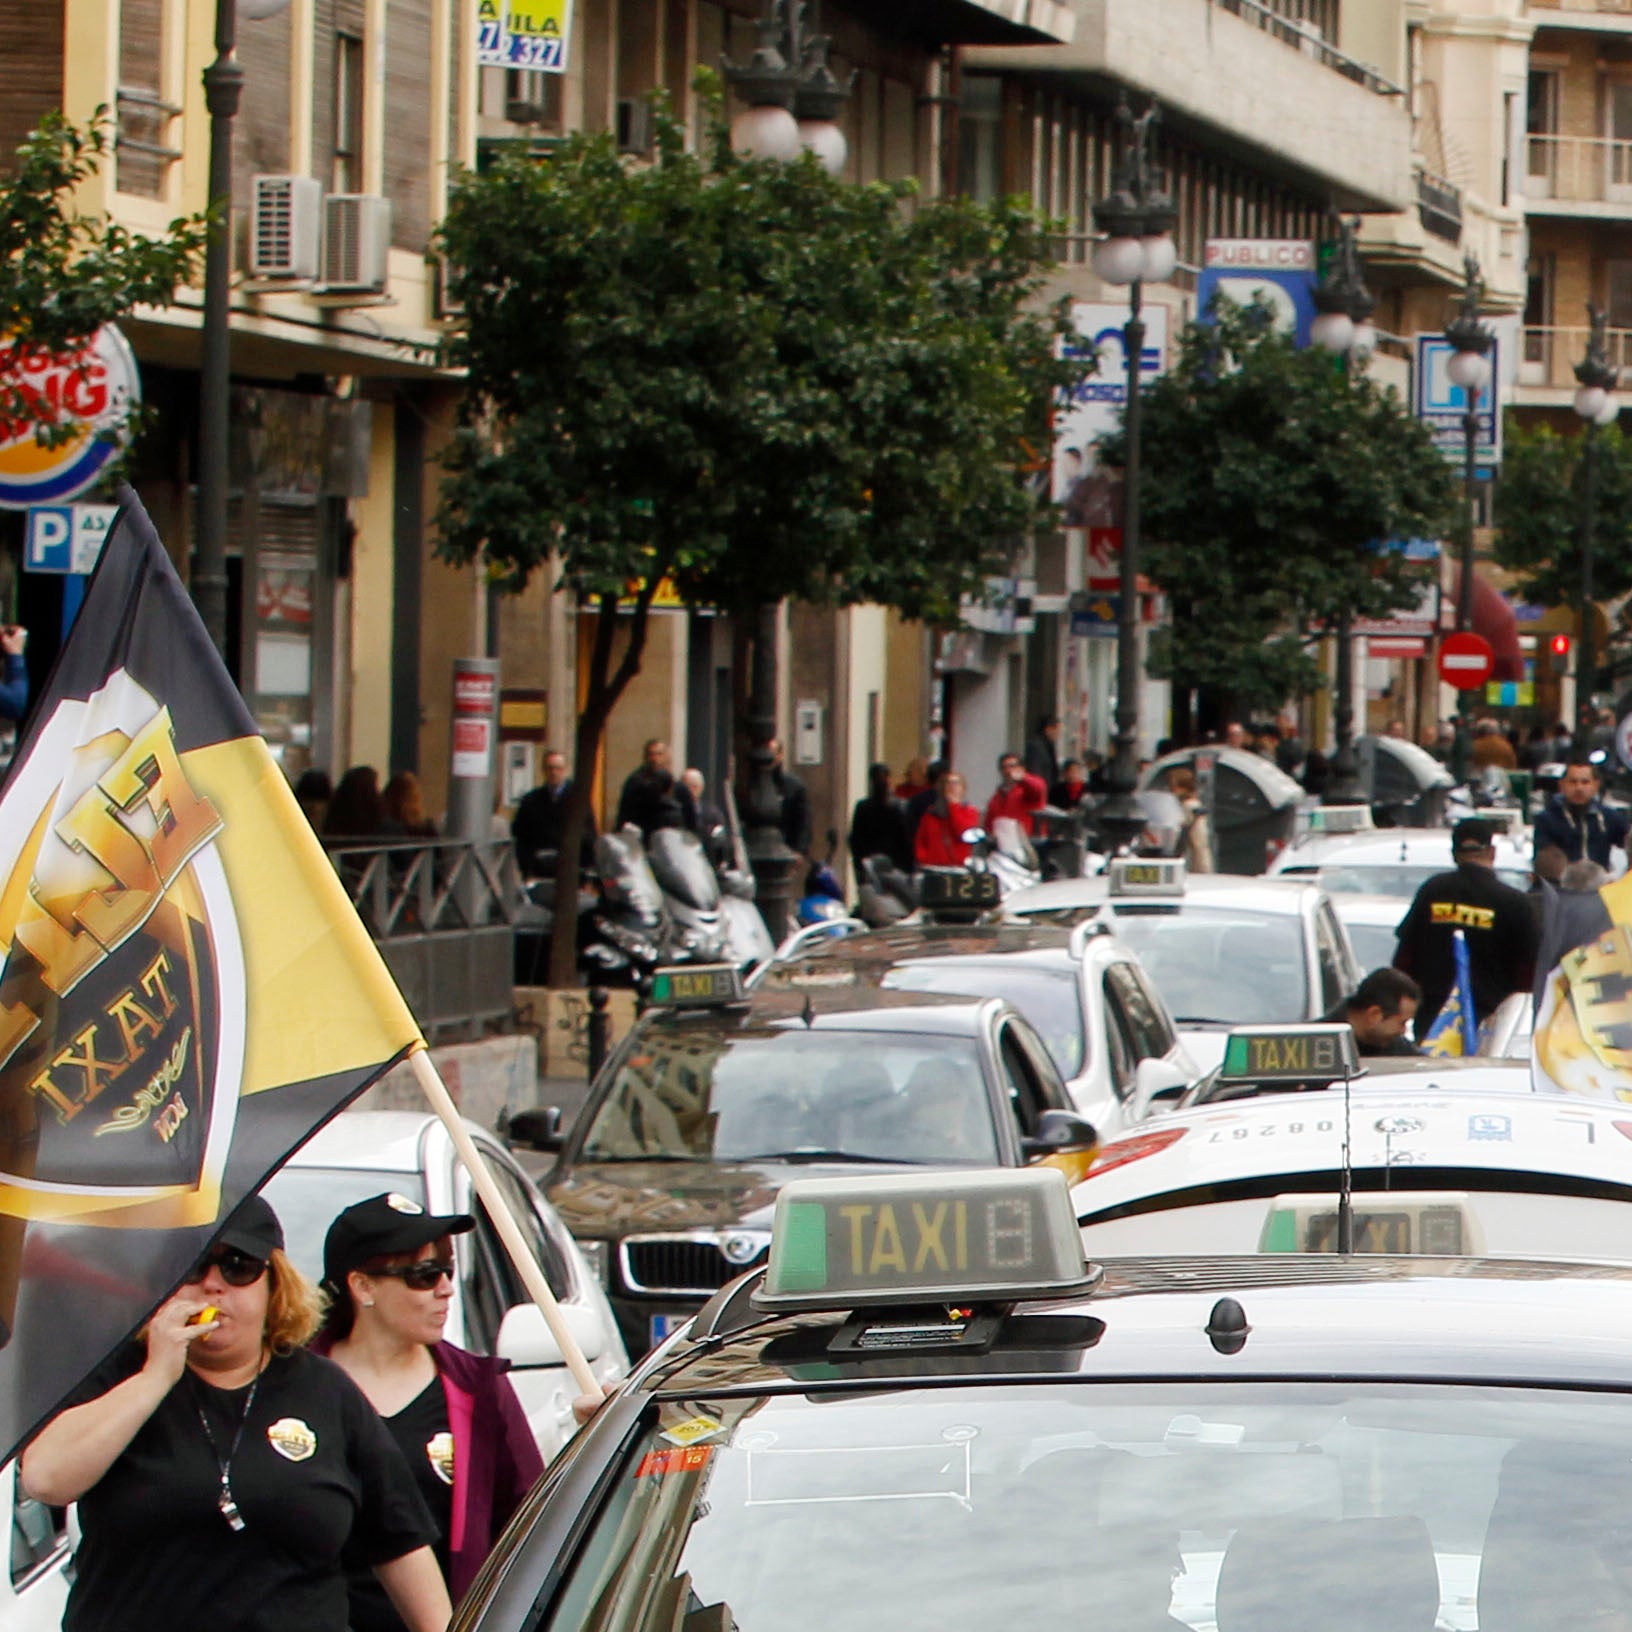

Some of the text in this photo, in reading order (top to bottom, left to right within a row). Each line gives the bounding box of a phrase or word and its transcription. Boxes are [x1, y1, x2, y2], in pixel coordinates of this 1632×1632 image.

[517, 36, 562, 67] 327
[31, 513, 69, 562] P
[944, 874, 996, 900] 123
[1125, 864, 1160, 886] TAXI
[1430, 902, 1495, 930] ELITE
[671, 972, 713, 998] TAXI
[1251, 1037, 1310, 1071] TAXI
[839, 1200, 970, 1276] TAXI
[686, 1454, 702, 1465] 15
